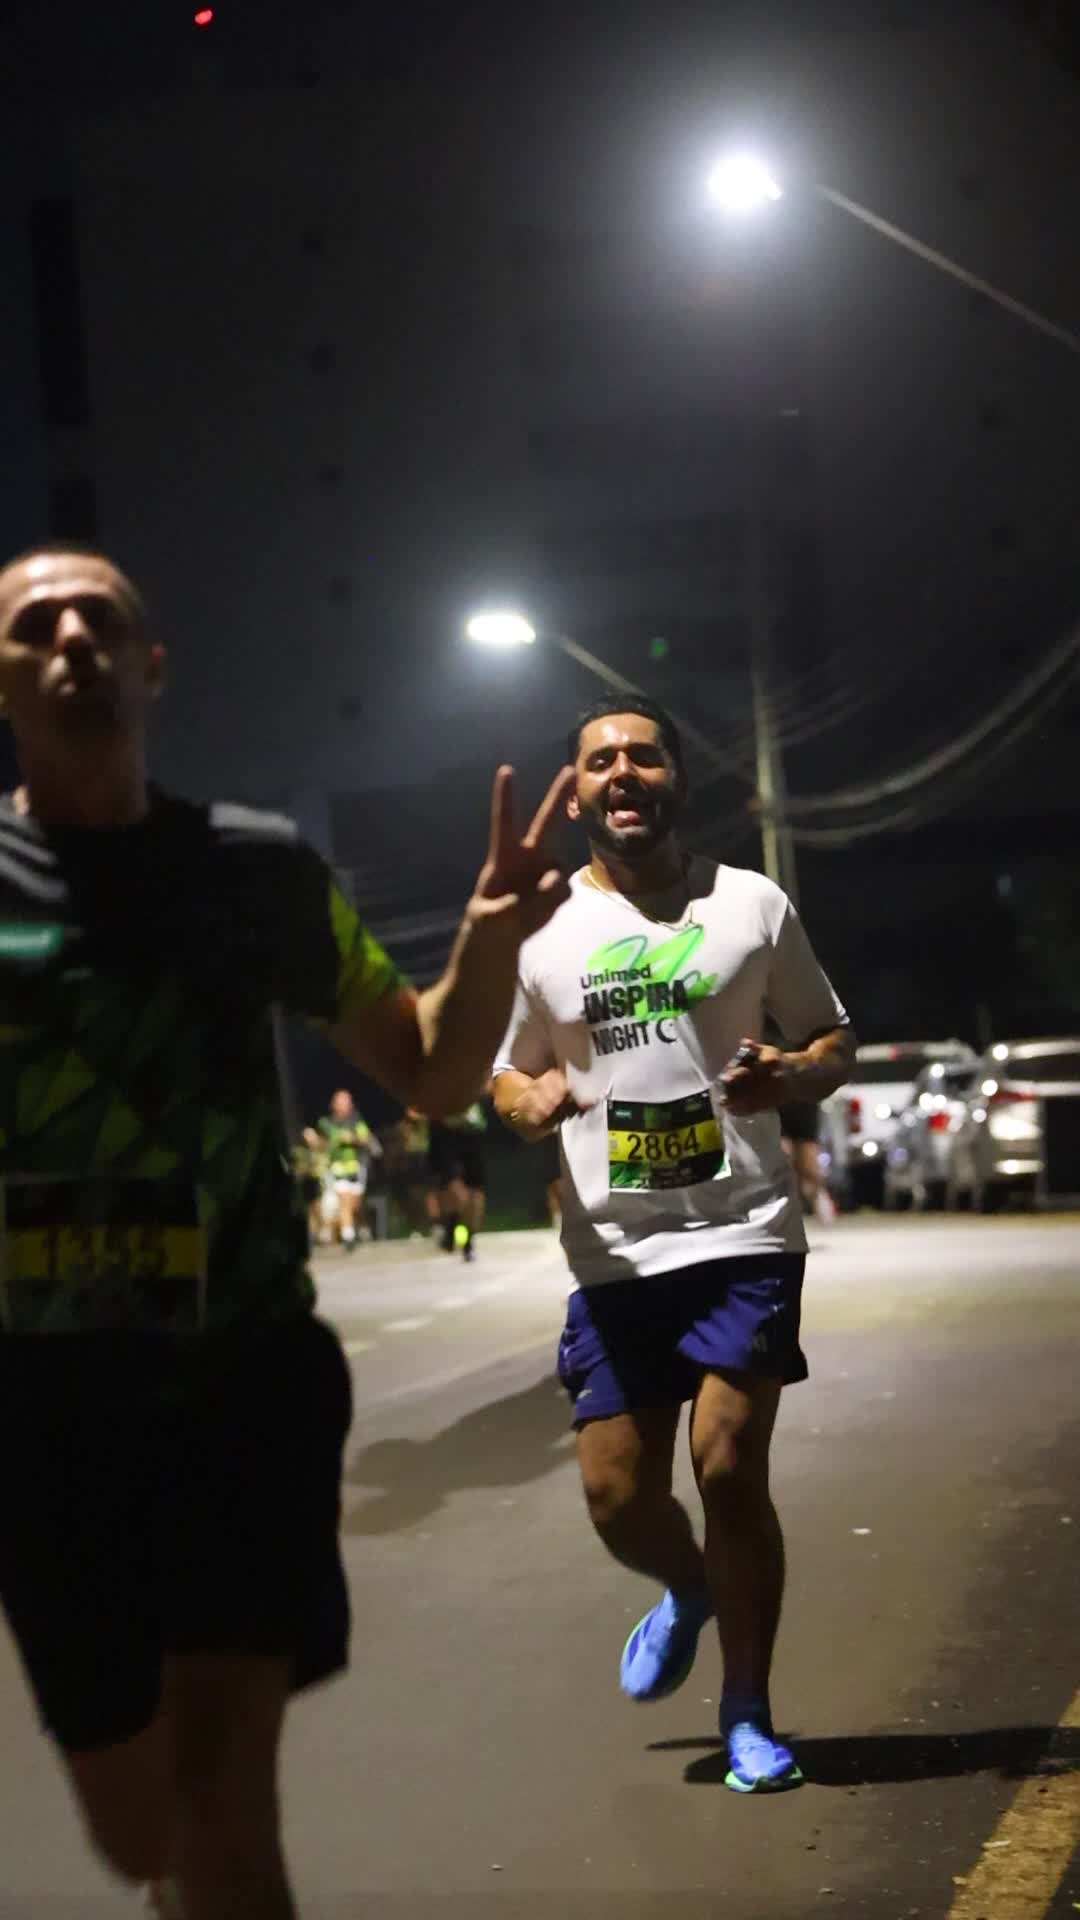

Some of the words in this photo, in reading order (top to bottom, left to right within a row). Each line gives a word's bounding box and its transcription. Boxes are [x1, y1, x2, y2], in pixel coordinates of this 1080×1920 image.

[580, 964, 652, 989] Unimed
[583, 979, 689, 1024] INSPIRA
[592, 1020, 649, 1056] NIGHT
[626, 1126, 700, 1161] 2864
